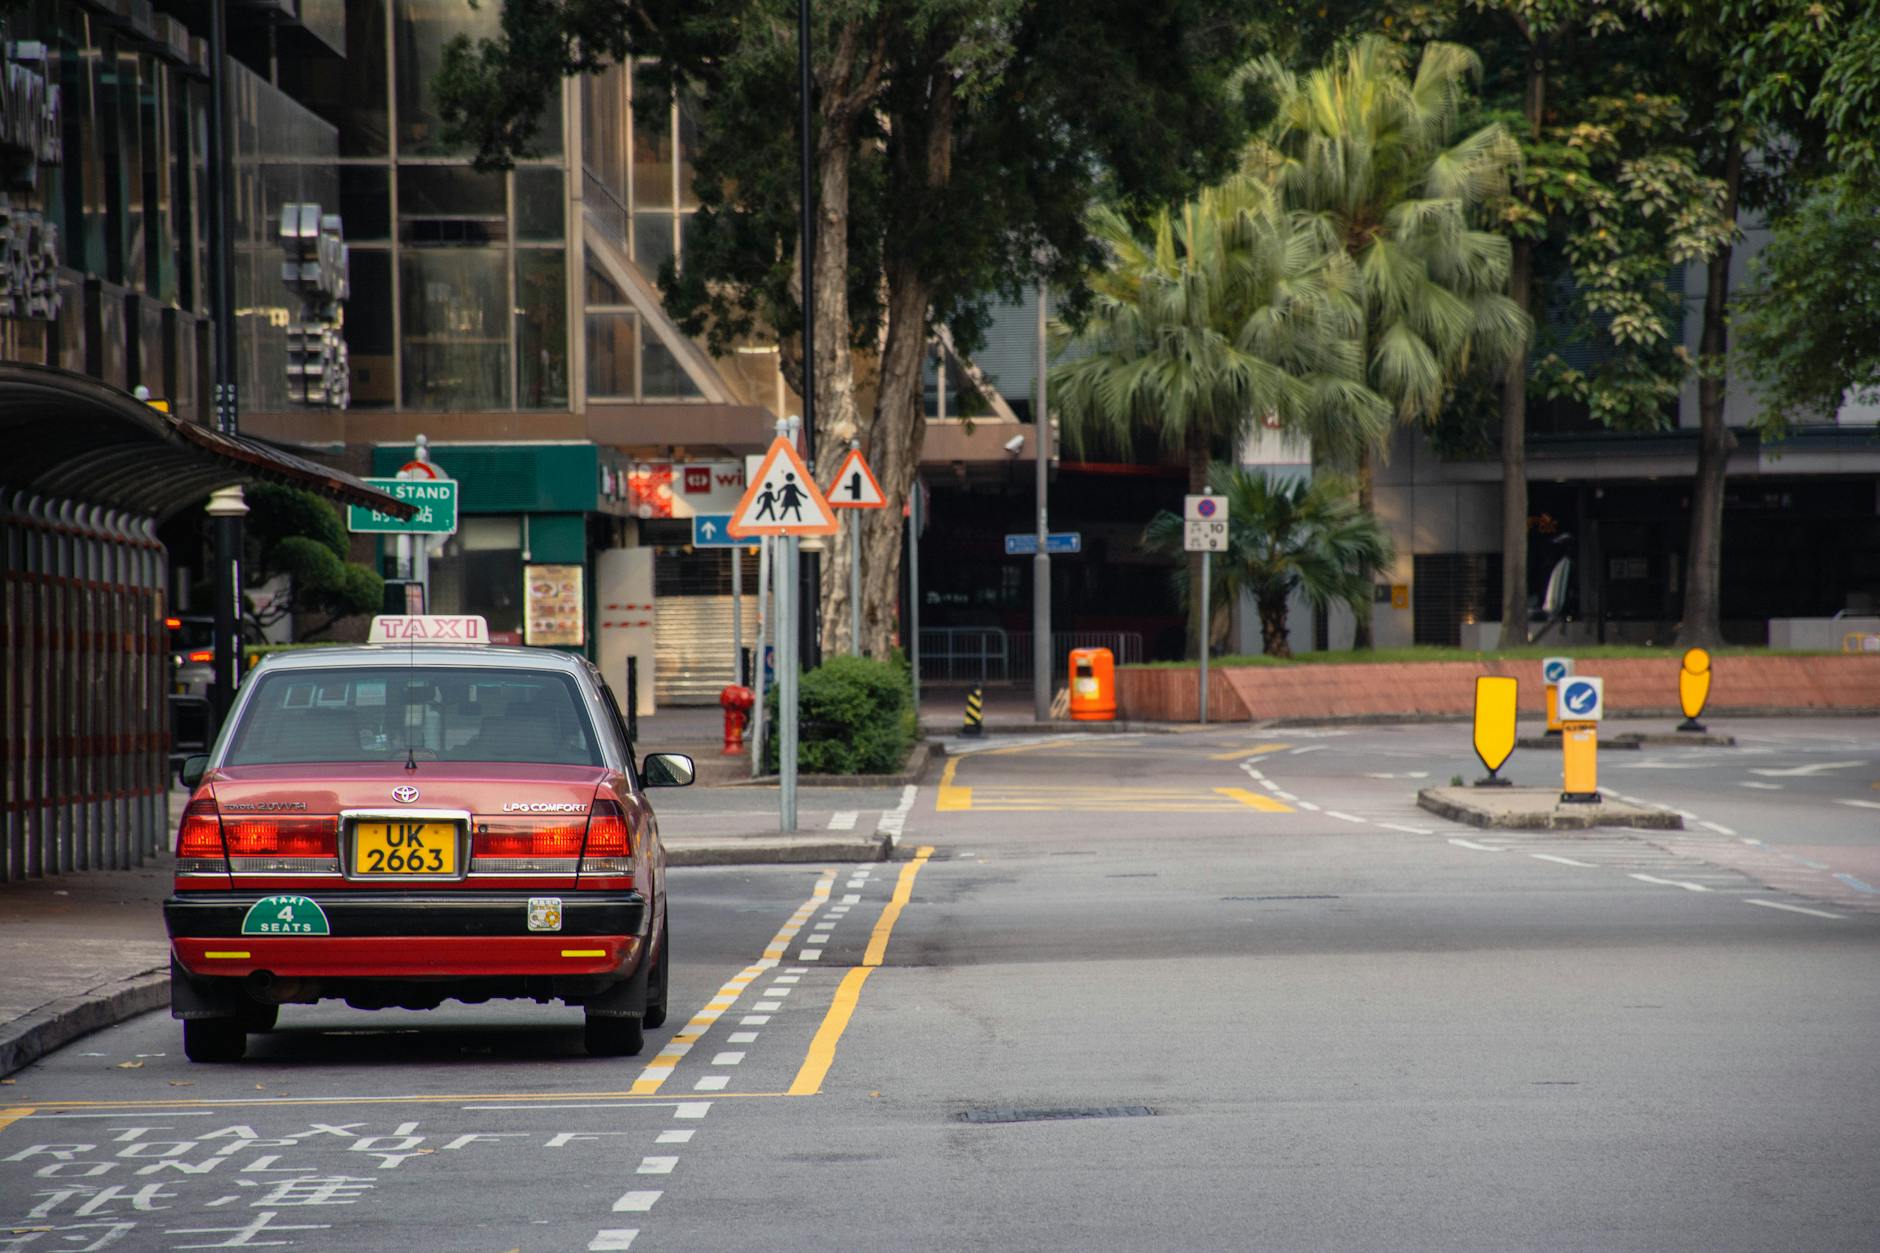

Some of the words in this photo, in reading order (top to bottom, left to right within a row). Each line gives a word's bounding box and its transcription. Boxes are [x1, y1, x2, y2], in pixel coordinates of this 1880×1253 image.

[395, 485, 450, 500] STAND
[372, 505, 433, 523] 的站
[380, 618, 478, 639] TAXI
[503, 802, 529, 812] LPG
[530, 803, 588, 812] COMFORT
[385, 824, 425, 848] UK
[367, 848, 443, 872] 2663
[268, 896, 305, 906] TAXI
[277, 905, 294, 922] 4
[260, 923, 312, 932] SEATS
[106, 1122, 421, 1142] TAXI
[348, 1132, 628, 1151] OFF
[33, 1153, 436, 1178] ONLY
